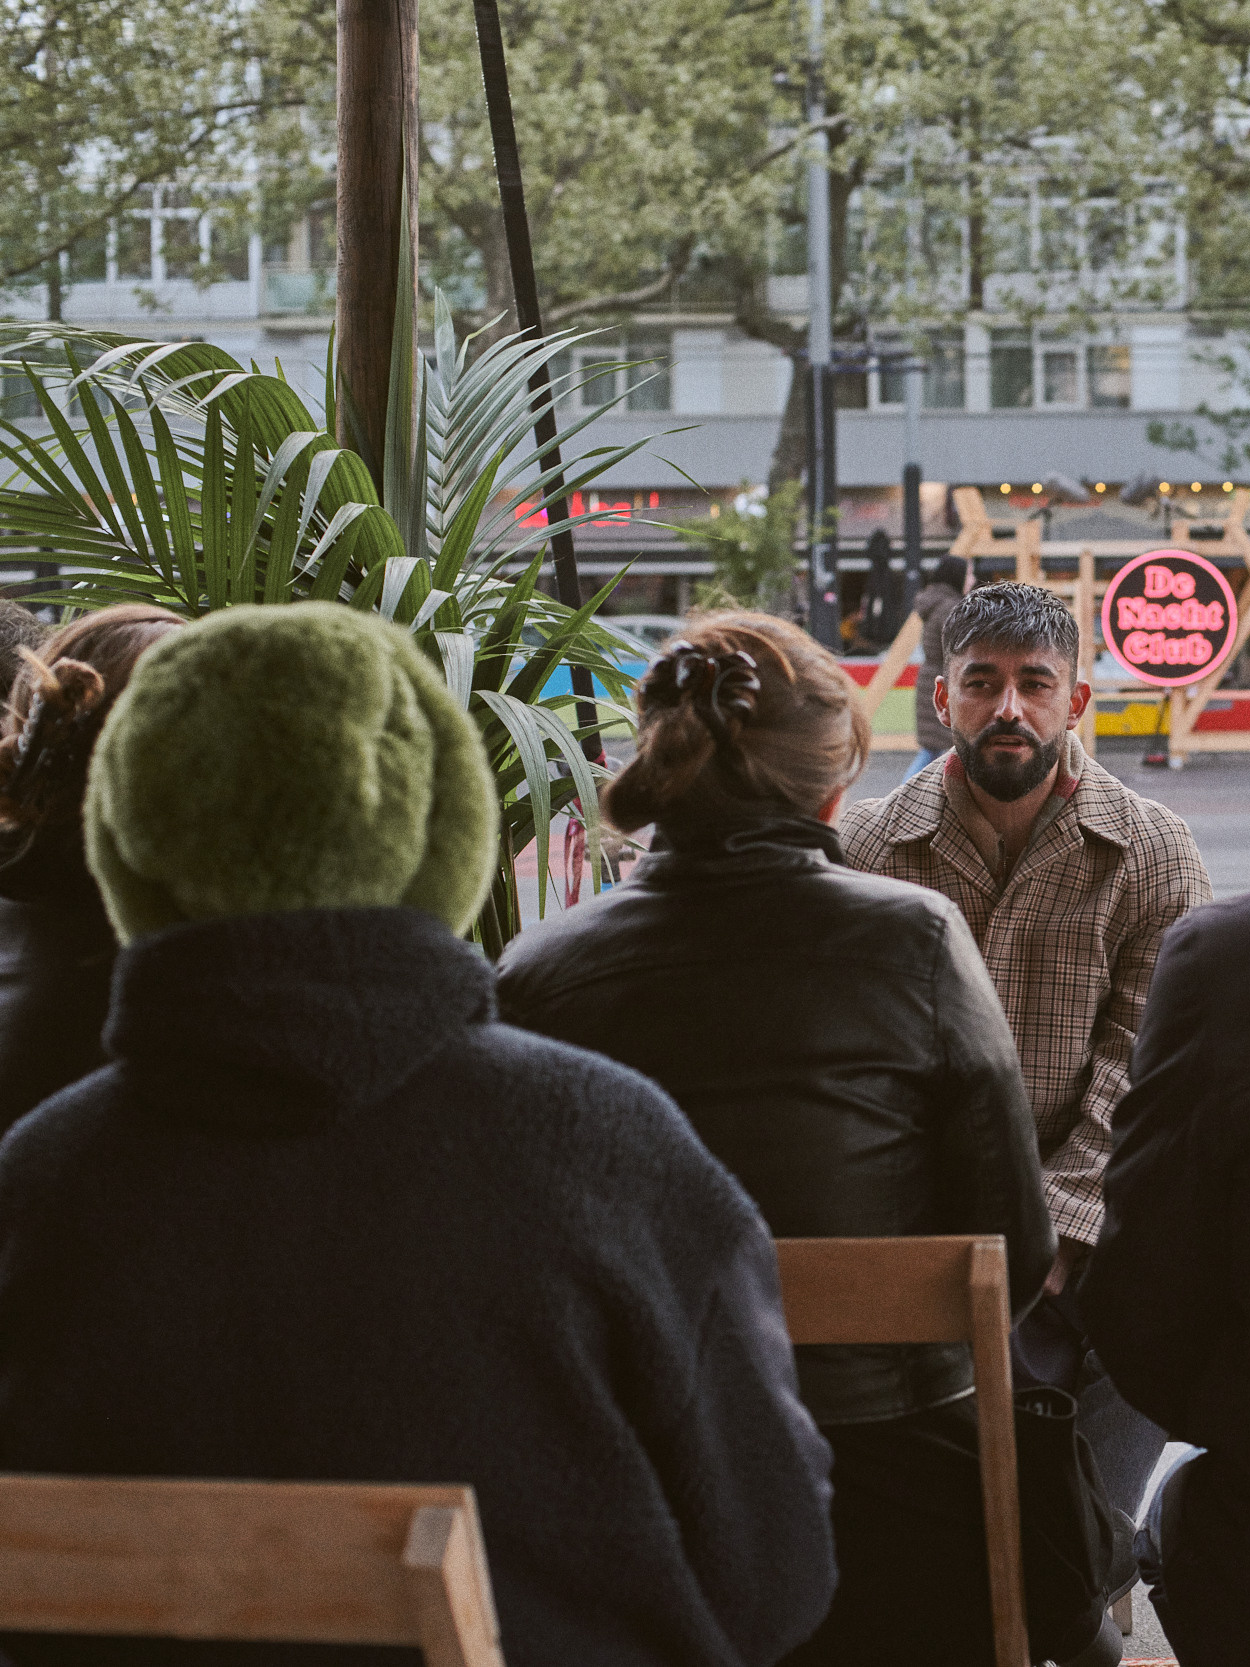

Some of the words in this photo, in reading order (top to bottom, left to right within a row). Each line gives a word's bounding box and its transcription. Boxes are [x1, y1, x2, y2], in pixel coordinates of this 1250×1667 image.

[1144, 565, 1196, 599] De
[1117, 597, 1225, 631] Nacht
[1123, 631, 1213, 665] Club
